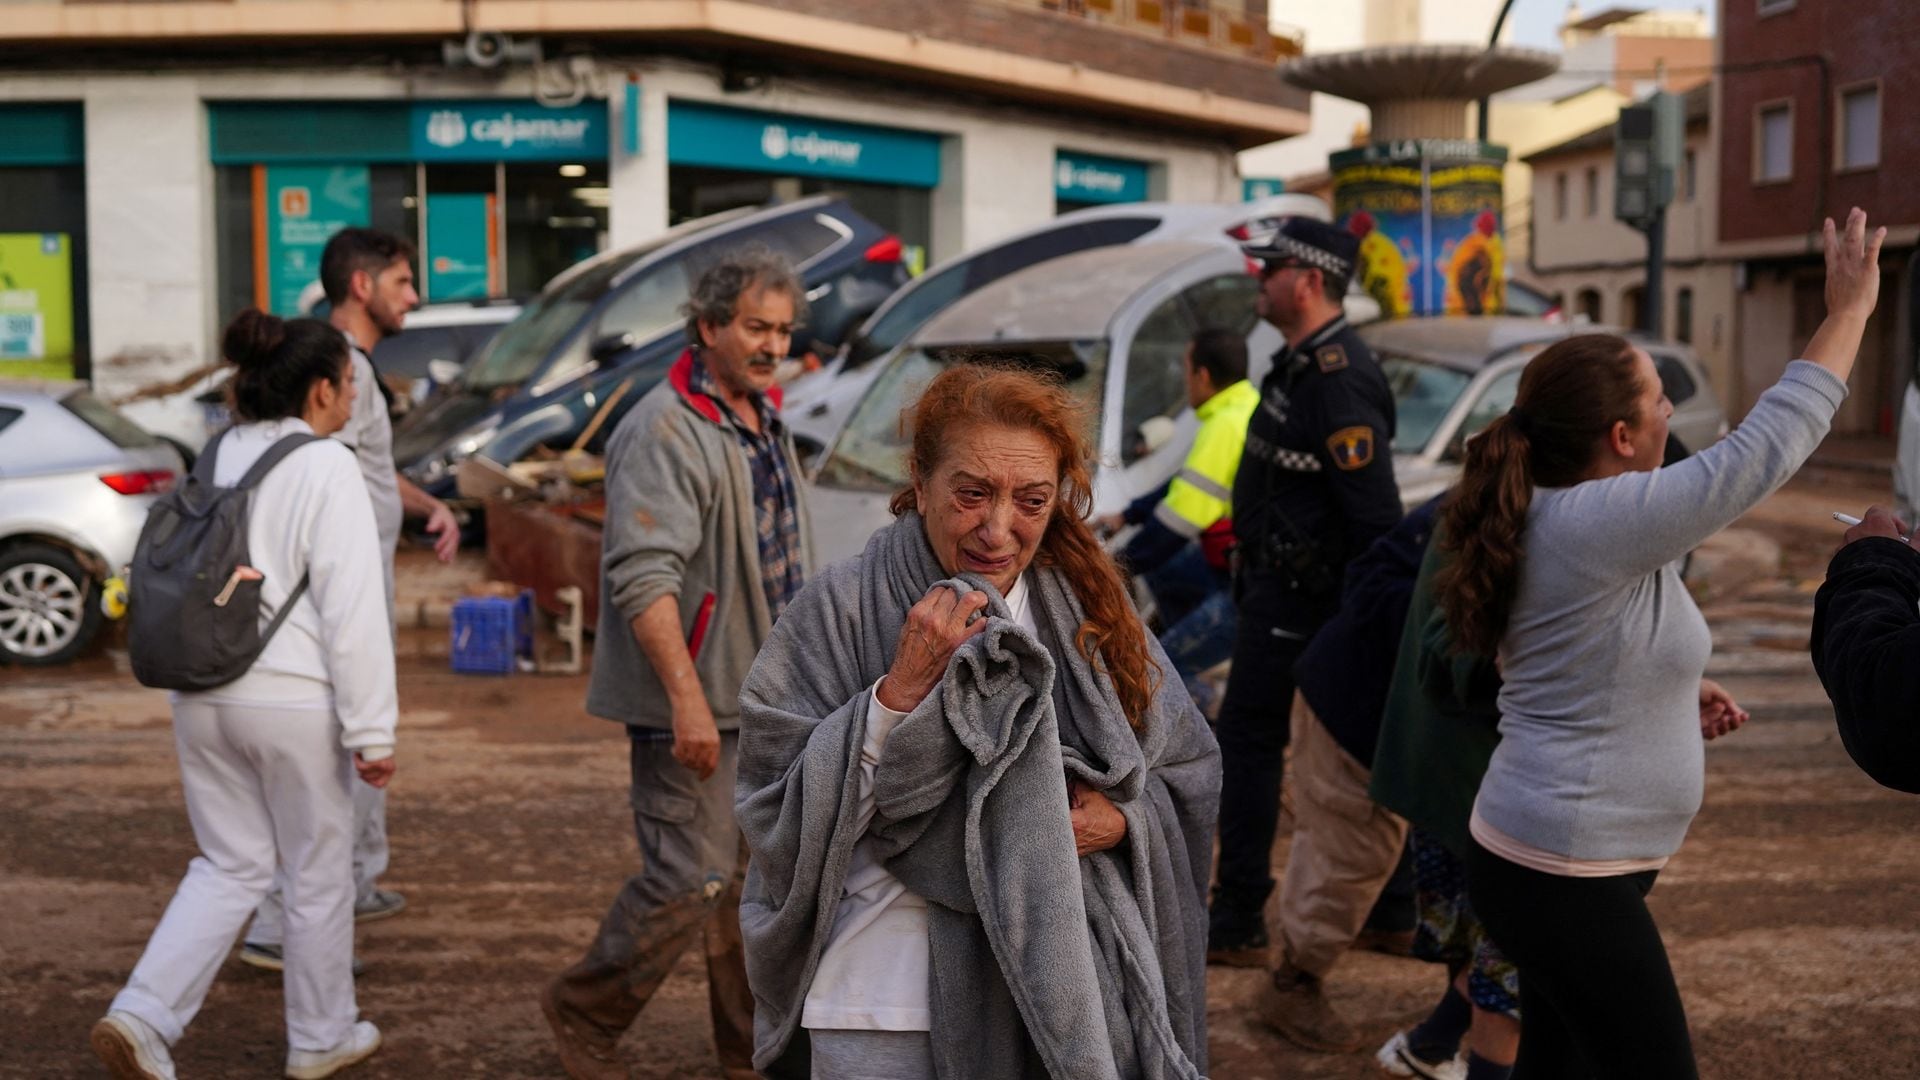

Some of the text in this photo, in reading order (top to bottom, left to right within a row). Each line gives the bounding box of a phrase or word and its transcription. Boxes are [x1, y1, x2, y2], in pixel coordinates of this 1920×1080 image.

[471, 112, 589, 148] cajamar
[790, 131, 862, 164] cajamar
[1389, 139, 1480, 160] LA TORRE
